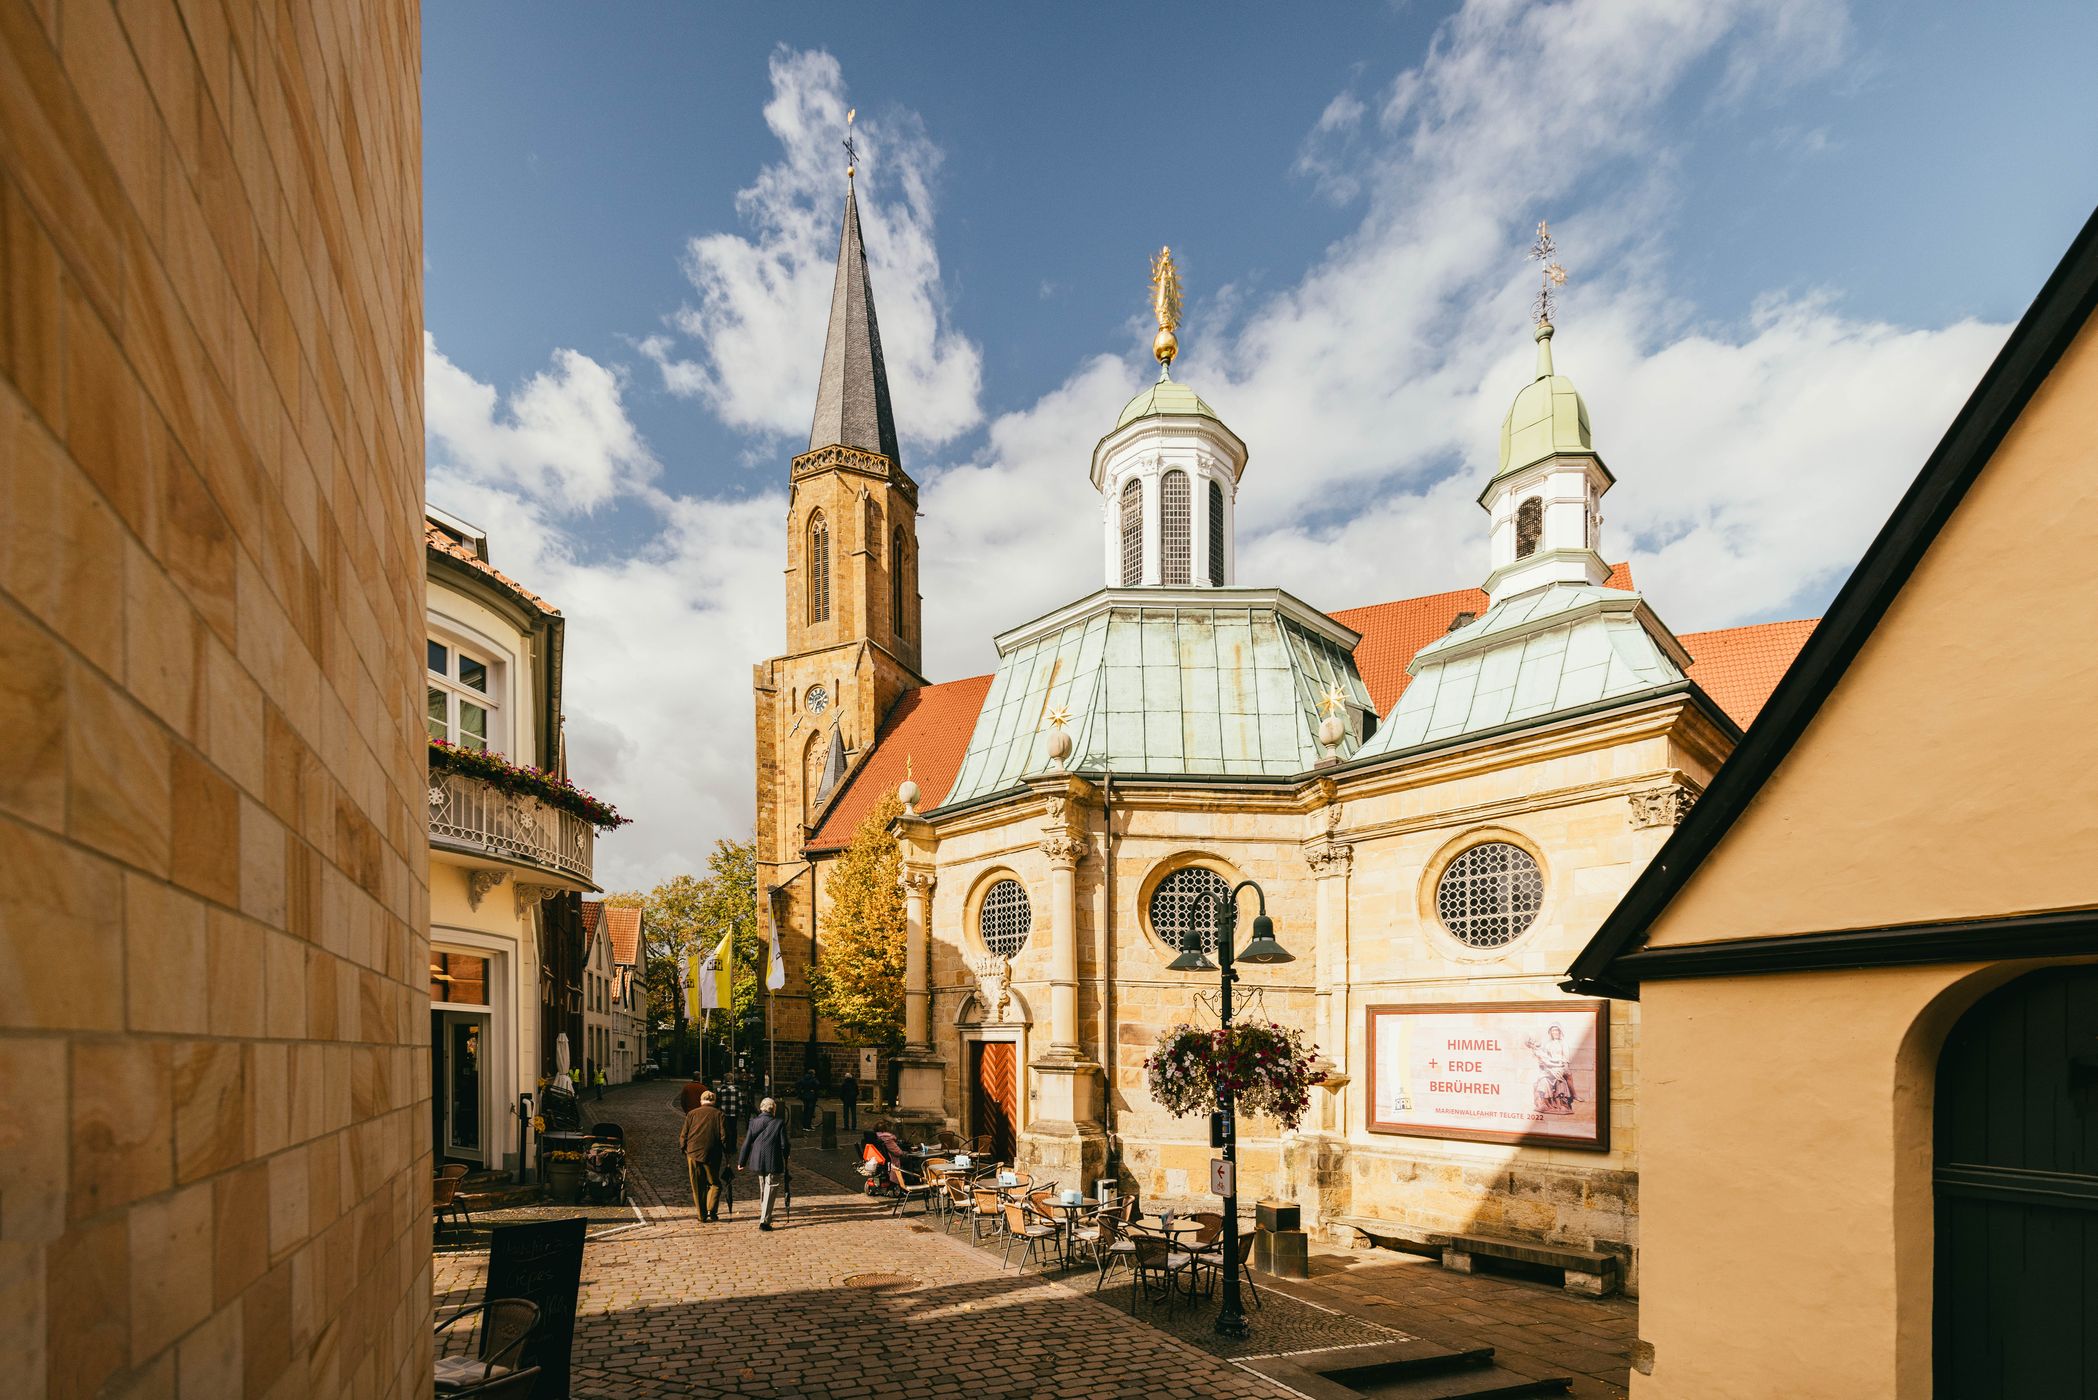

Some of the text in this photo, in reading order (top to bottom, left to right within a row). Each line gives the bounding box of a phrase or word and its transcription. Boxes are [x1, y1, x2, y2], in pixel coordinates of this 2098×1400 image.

[1447, 1039, 1502, 1051] HIMMEL
[1448, 1061, 1482, 1072] ERDE
[1429, 1080, 1500, 1095] BERÜHREN
[1435, 1108, 1545, 1121] MARIENWALLFAHRT TELGTE 2022
